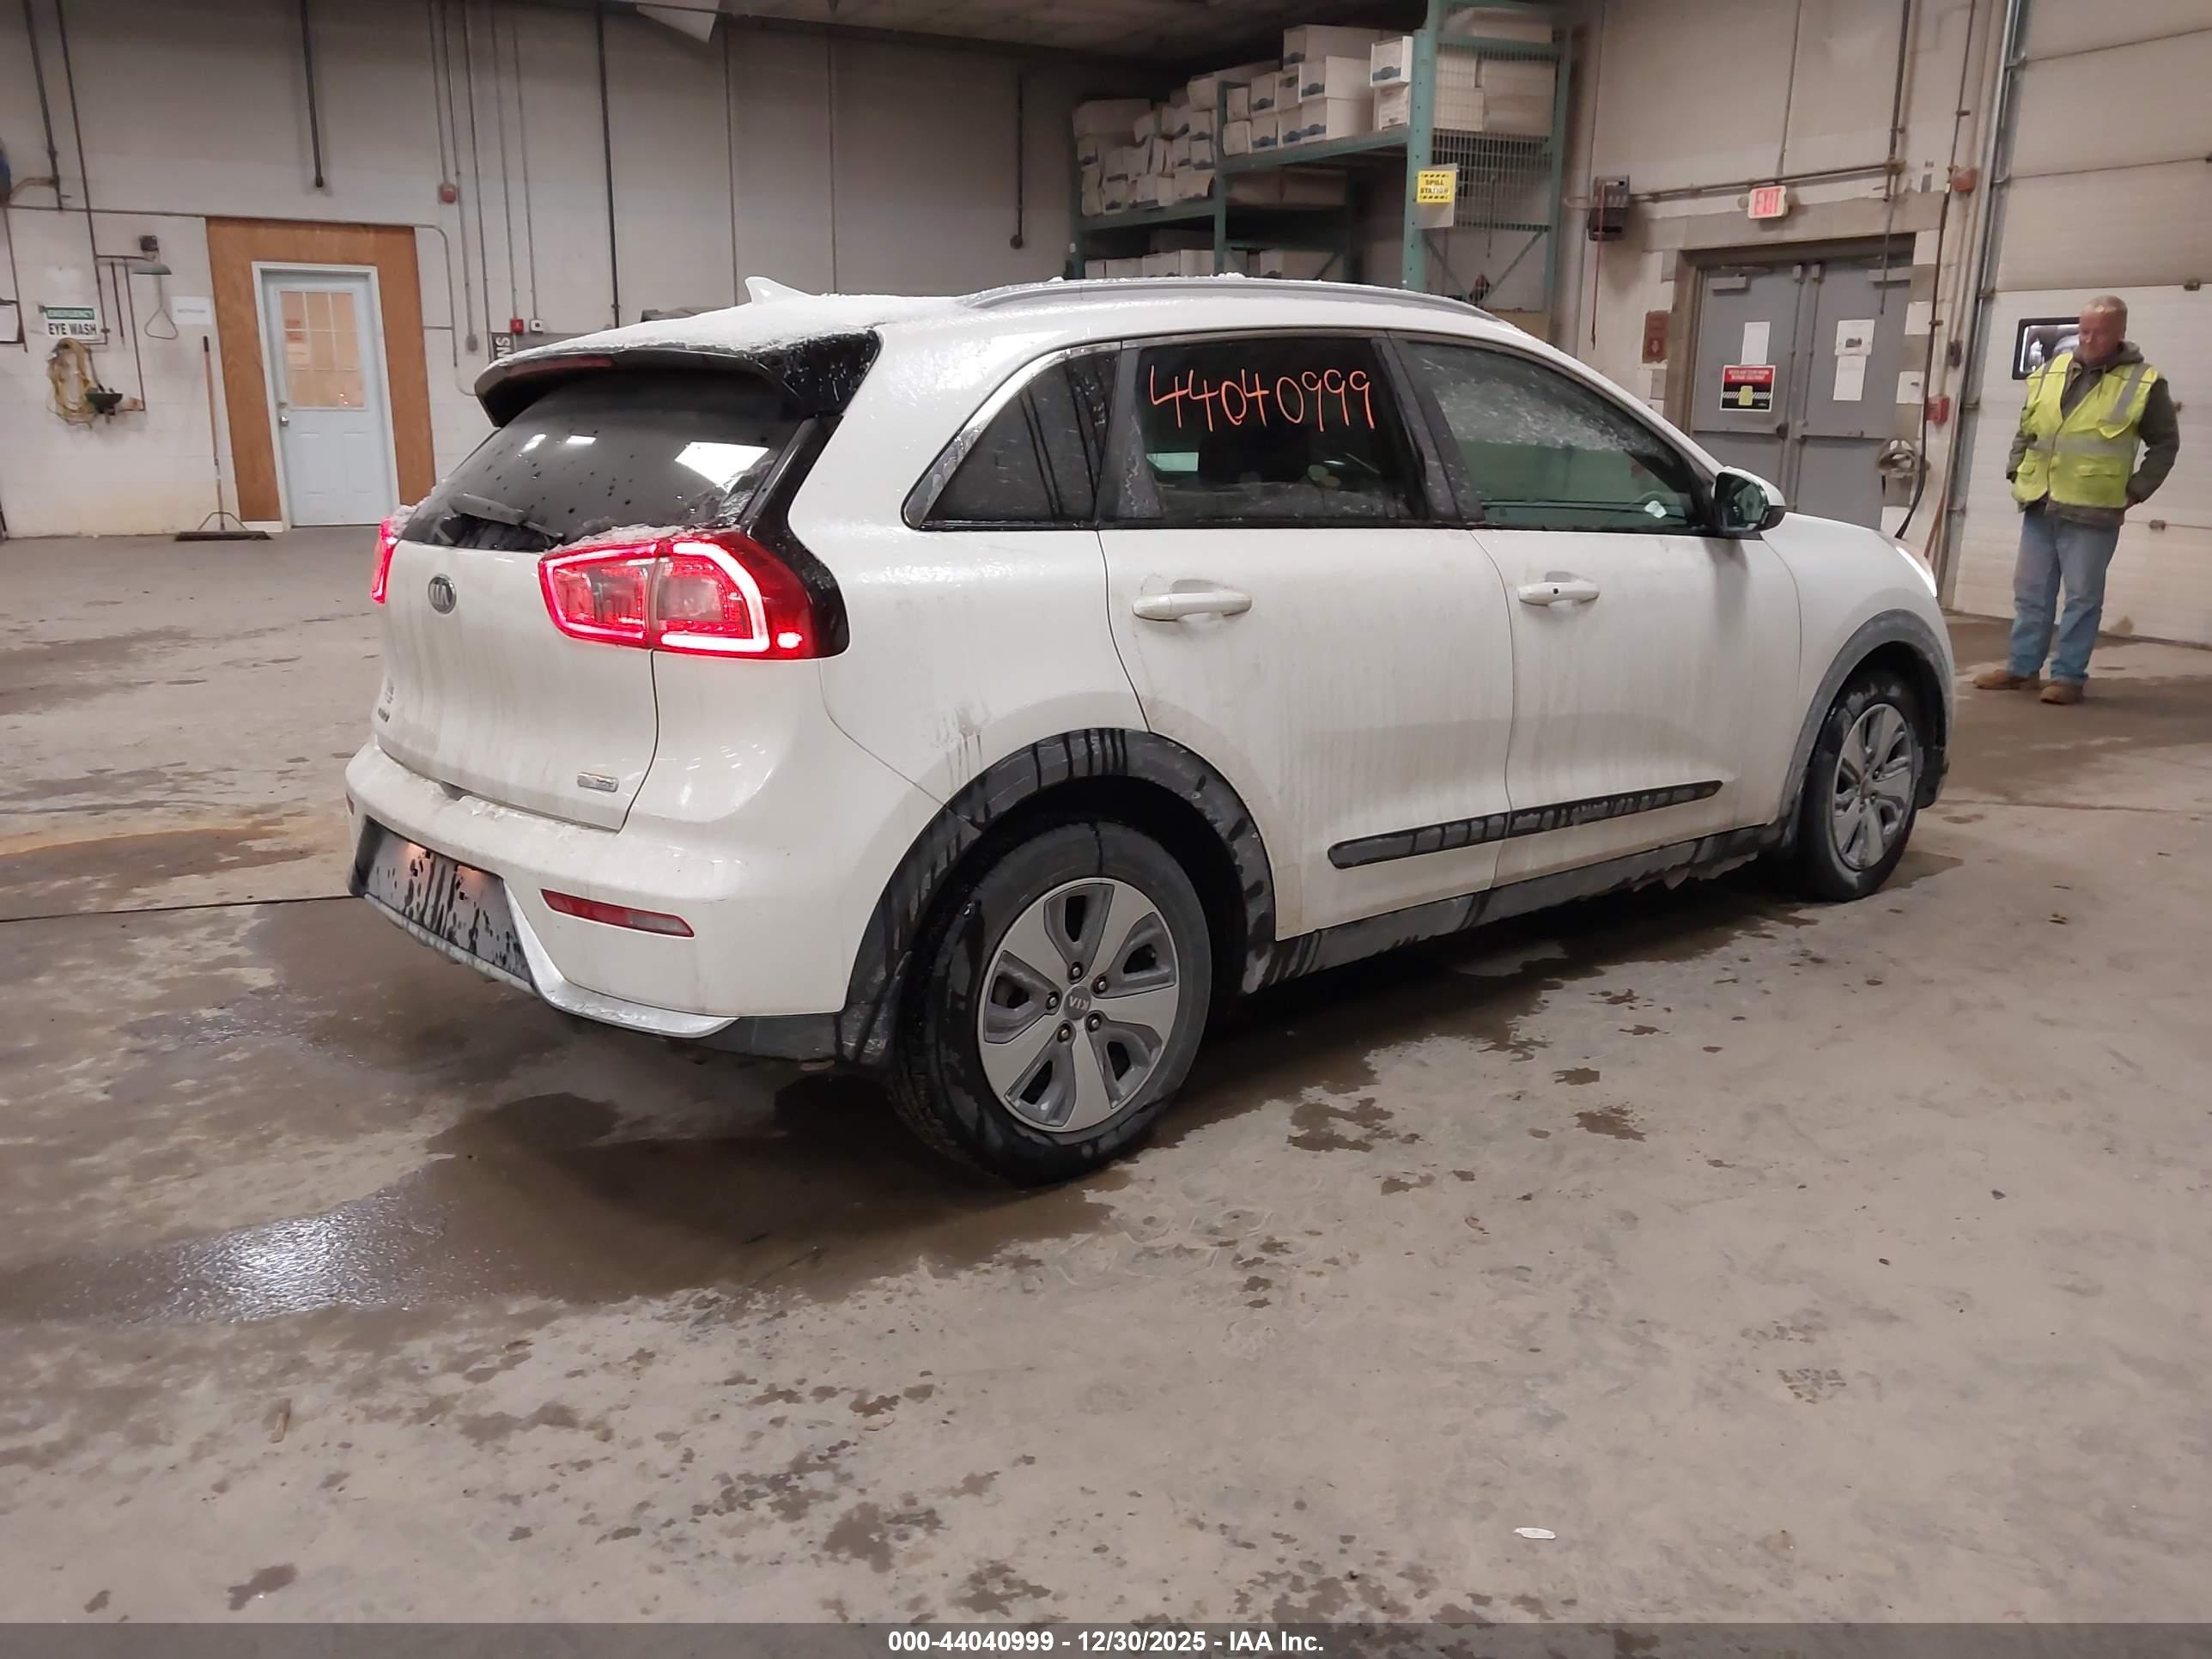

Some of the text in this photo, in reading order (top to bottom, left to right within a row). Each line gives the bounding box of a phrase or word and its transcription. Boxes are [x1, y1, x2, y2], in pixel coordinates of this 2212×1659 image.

[48, 323, 97, 335] EYE WASH
[1149, 364, 1375, 433] 44040999
